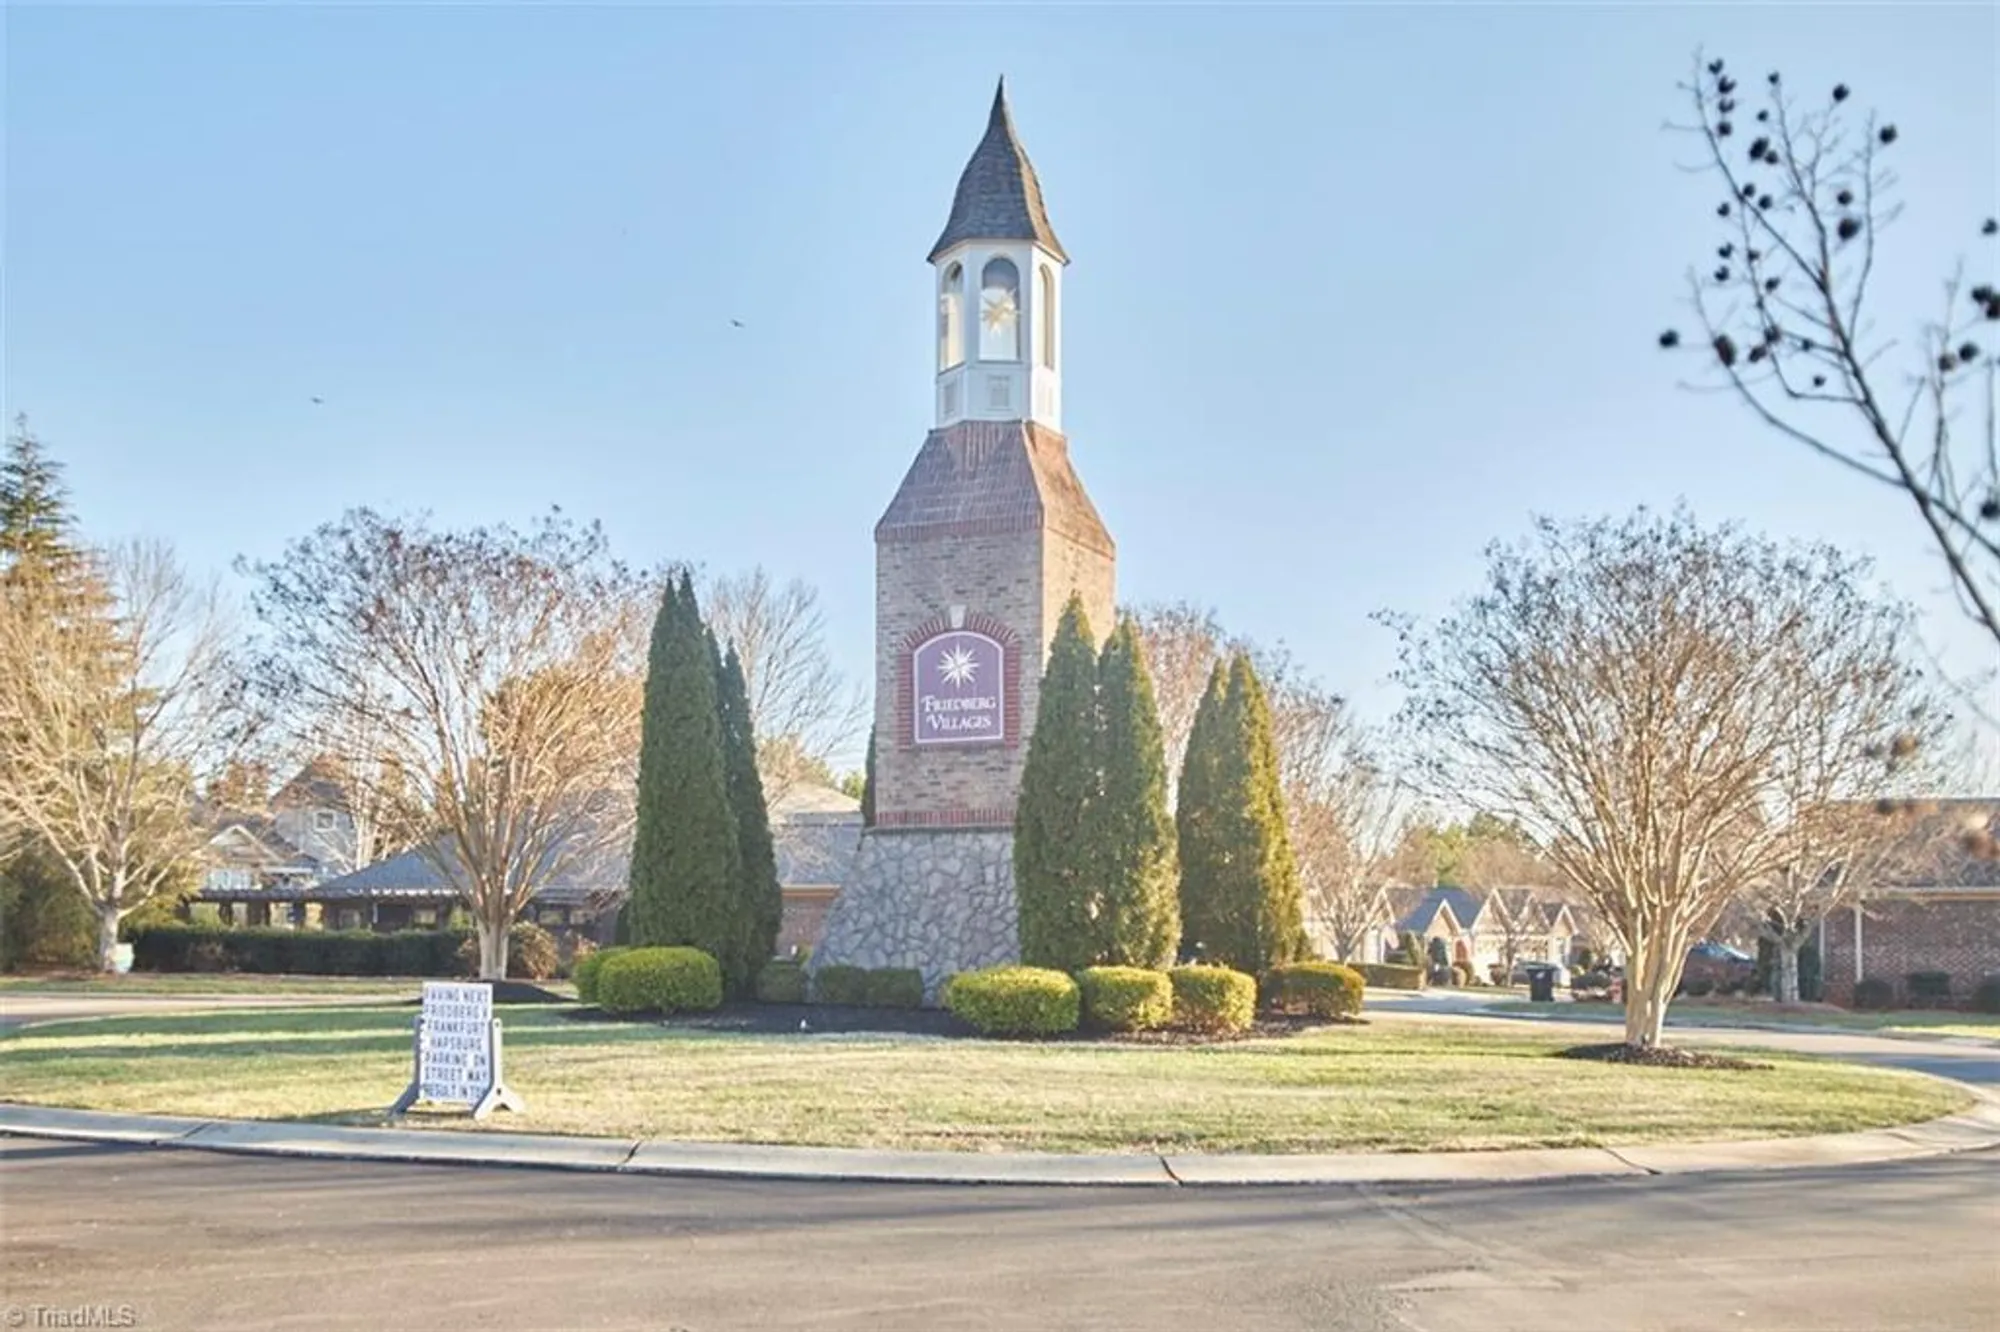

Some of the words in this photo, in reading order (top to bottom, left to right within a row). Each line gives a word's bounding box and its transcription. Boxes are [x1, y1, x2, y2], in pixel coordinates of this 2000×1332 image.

[427, 1020, 486, 1035] FRANKFURT
[430, 1035, 482, 1051] HAPSBURG
[425, 1050, 468, 1068] PARKING
[425, 1066, 462, 1081] STREET
